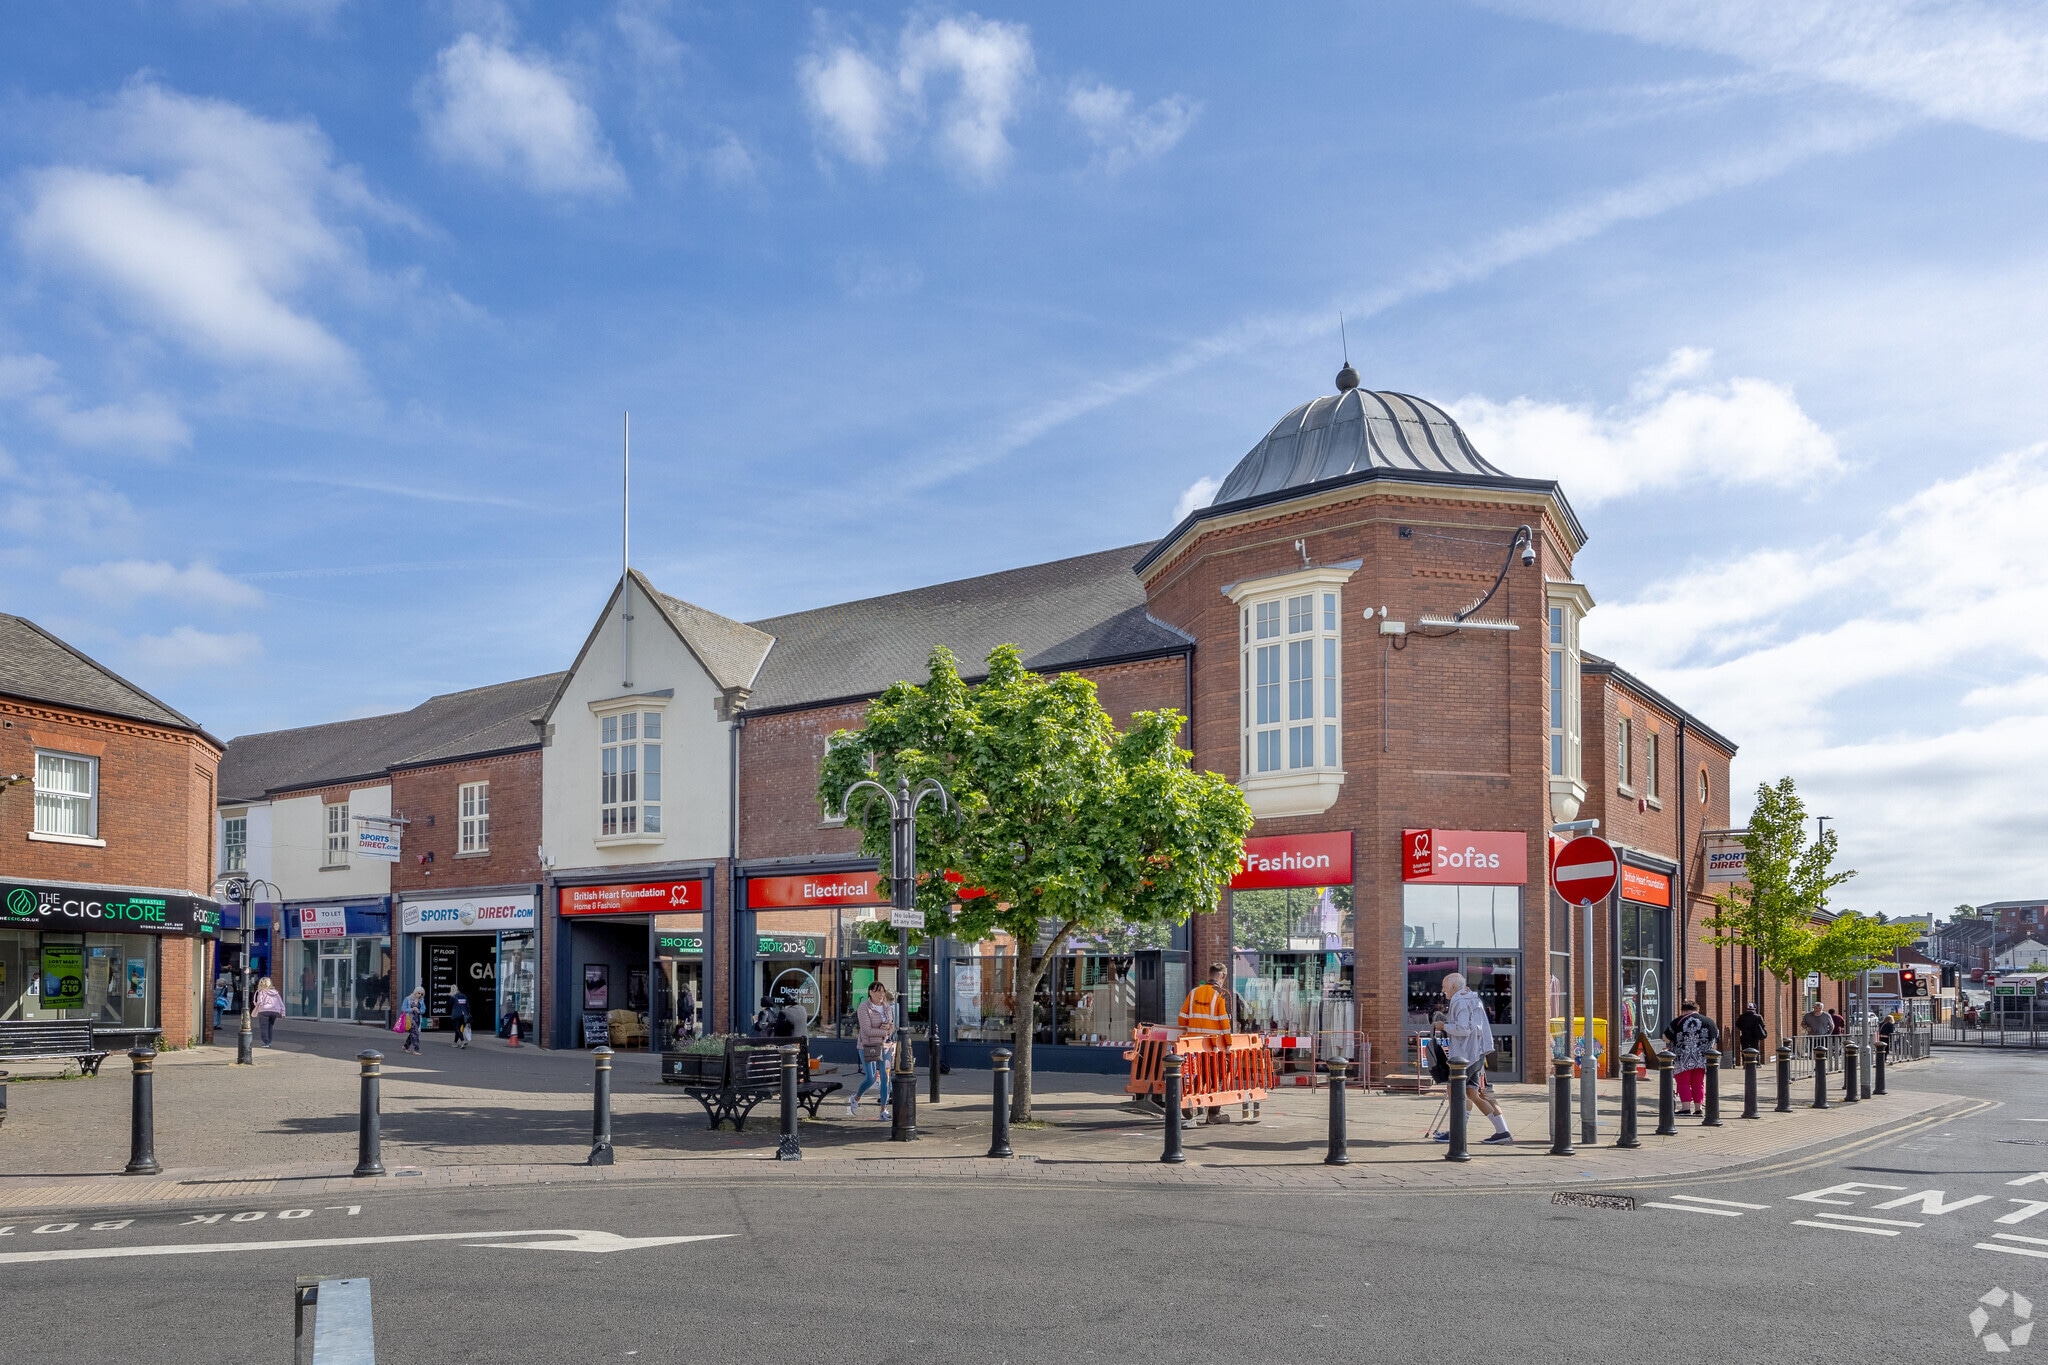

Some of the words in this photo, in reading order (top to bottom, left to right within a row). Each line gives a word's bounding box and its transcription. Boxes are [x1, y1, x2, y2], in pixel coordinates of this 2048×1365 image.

[360, 833, 389, 842] SPORTS
[1247, 851, 1330, 872] Fashion
[1437, 845, 1500, 868] Sofas
[574, 891, 598, 901] British
[599, 890, 620, 899] Heart
[621, 888, 665, 898] Foundation
[803, 880, 868, 898] Electrical
[39, 892, 60, 904] THE
[39, 900, 102, 918] e-CIG
[104, 903, 166, 921] STORE
[421, 909, 459, 922] SPORTS
[478, 906, 533, 920] DIRECT.COM
[61, 984, 79, 993] £10
[780, 986, 809, 994] Discover
[179, 1205, 362, 1226] LOOK
